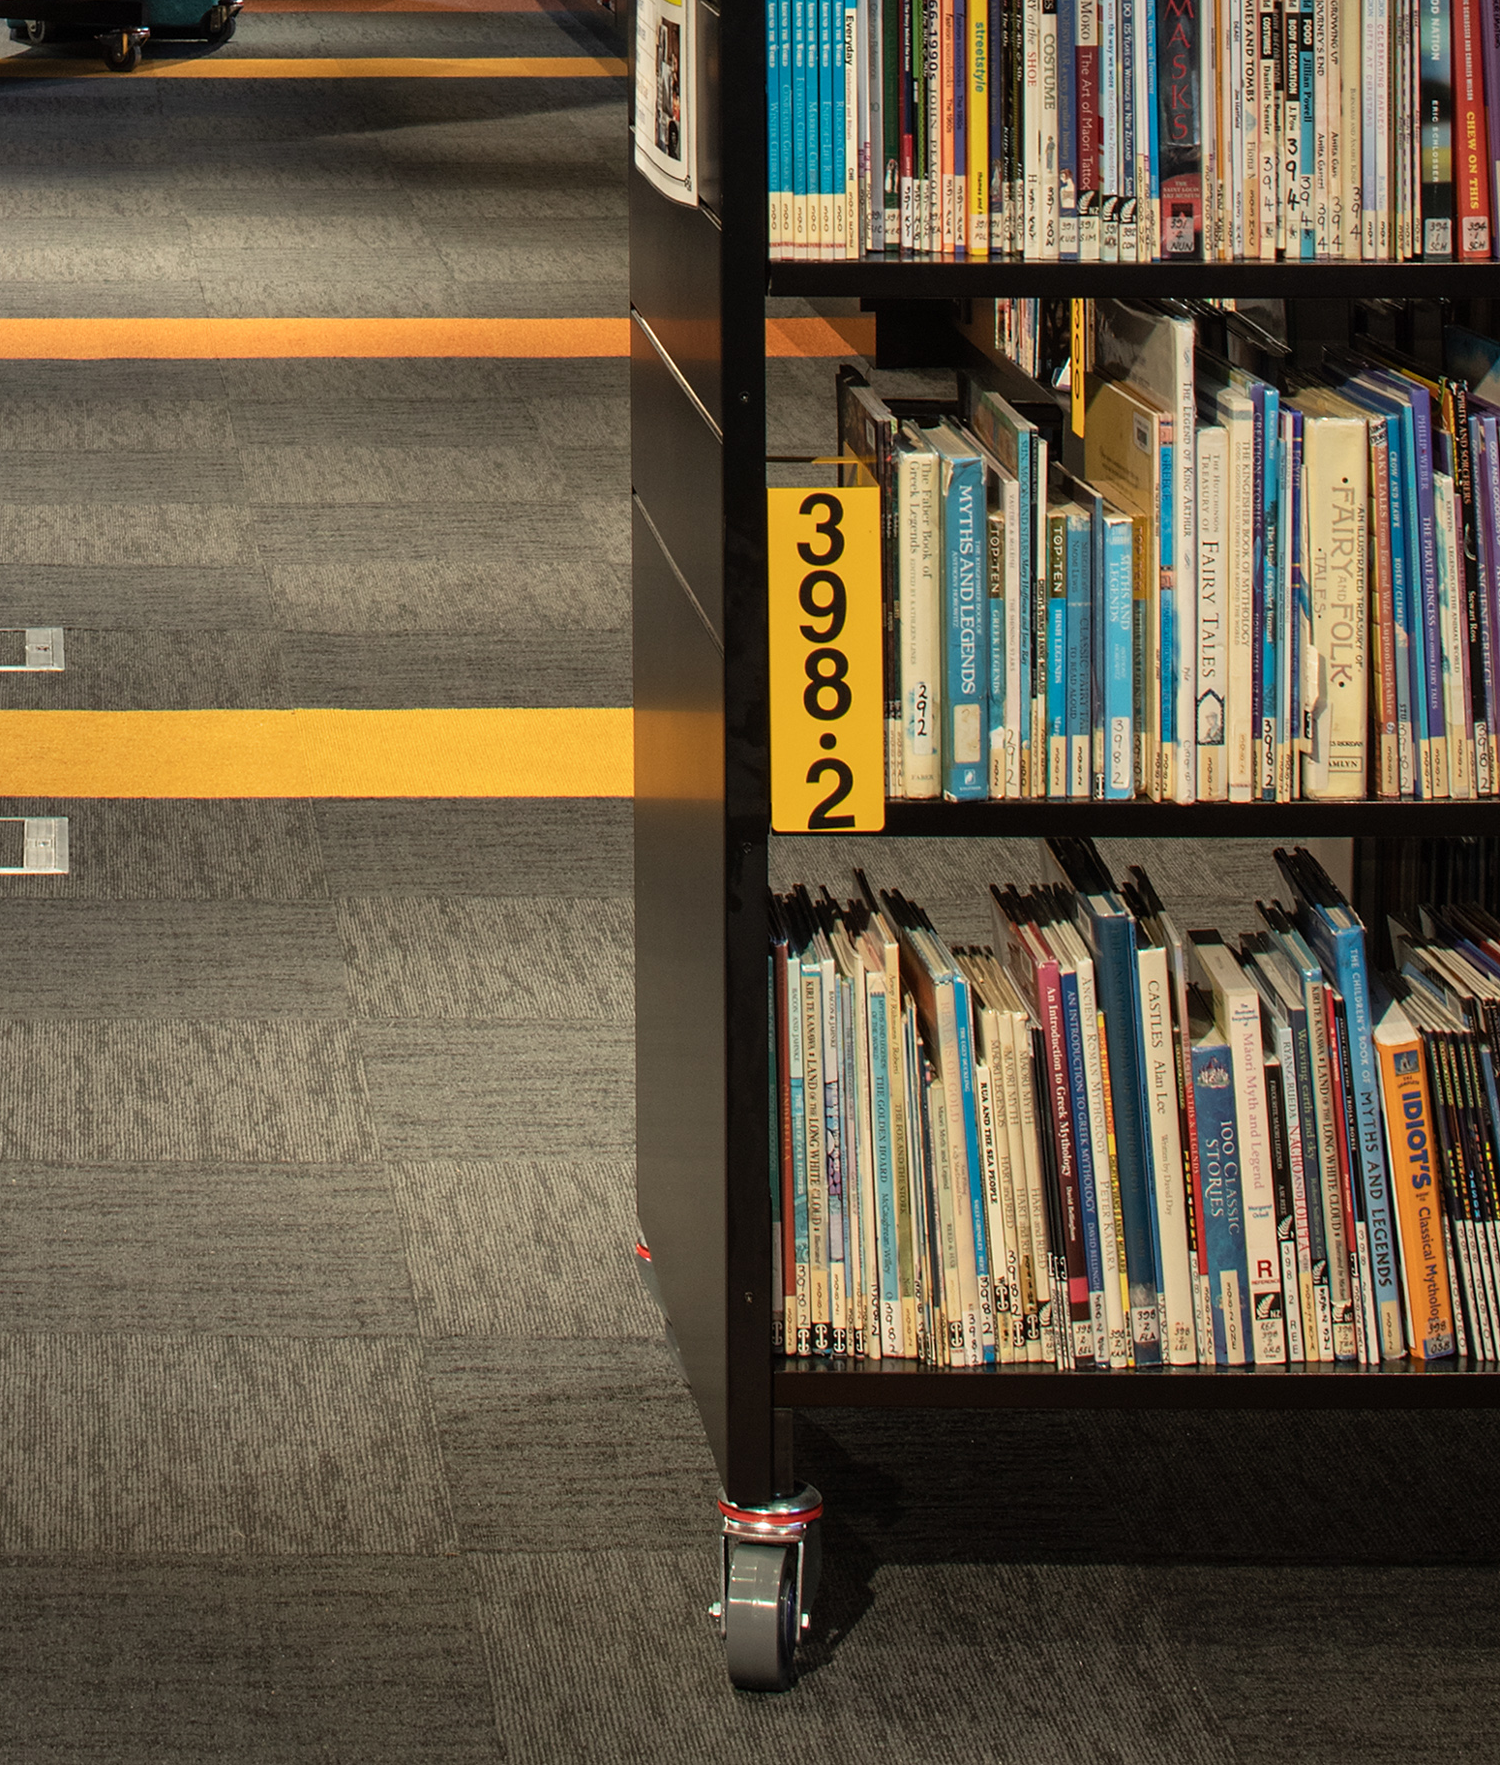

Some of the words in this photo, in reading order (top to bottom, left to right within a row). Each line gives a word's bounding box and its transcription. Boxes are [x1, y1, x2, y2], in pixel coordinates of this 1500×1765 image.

[1027, 14, 1037, 25] of
[1027, 28, 1037, 44] the
[1262, 16, 1271, 56] COSTUMES
[1287, 19, 1297, 40] BODY
[1302, 19, 1313, 46] FOOD
[1316, 0, 1325, 52] JOURNEY'S
[1330, 0, 1338, 46] GROWING
[845, 15, 854, 65] Everyday
[1245, 28, 1254, 52] AND
[1430, 18, 1440, 60] NATION
[974, 22, 987, 93] streetstyle
[1028, 52, 1038, 87] SHOE
[1043, 34, 1055, 110] COSTUME
[1081, 52, 1092, 75] The
[1287, 43, 1297, 95] DECORATION
[1302, 58, 1312, 87] Jillian
[1317, 57, 1325, 76] END
[1330, 50, 1338, 65] UP
[1081, 79, 1092, 97] Art
[1245, 56, 1255, 102] TOMBS
[928, 89, 937, 130] JOHN
[1081, 101, 1092, 114] of
[1303, 90, 1312, 122] Powell
[1081, 117, 1093, 152] Maori
[1466, 111, 1478, 150] CHEW
[1468, 155, 1478, 173] ON
[1469, 177, 1479, 209] THIS
[1183, 382, 1191, 399] THE
[1182, 404, 1192, 442] LEGEND
[922, 461, 931, 482] The
[1183, 447, 1192, 461] OF
[908, 461, 920, 495] Greek
[1183, 466, 1192, 492] KING
[922, 488, 931, 526] Faber
[959, 485, 973, 555] MYTHS
[1183, 497, 1193, 537] ARTHUR
[908, 497, 920, 554] Legends
[1266, 526, 1274, 540] The
[1331, 487, 1353, 572] FAIRY
[922, 532, 932, 560] Book
[1265, 542, 1274, 567] Magic
[923, 565, 932, 578] of
[960, 559, 973, 600] AND
[1119, 554, 1130, 598] MYTHS
[1201, 540, 1218, 604] FAIRY
[1266, 571, 1274, 582] of
[1314, 554, 1326, 615] TALES
[1337, 576, 1348, 601] AND
[1109, 562, 1120, 622] LEGENDS
[1265, 584, 1274, 613] Spider
[1121, 603, 1131, 630] AND
[1266, 616, 1274, 643] Woman
[961, 605, 976, 693] LEGENDS
[1202, 614, 1218, 678] TALES
[1330, 603, 1354, 681] FOLK
[795, 492, 856, 830] 398.2
[806, 981, 814, 1001] KIRI
[806, 1004, 815, 1012] TE
[1047, 987, 1056, 998] An
[1148, 980, 1163, 1048] CASTLES
[807, 1015, 816, 1049] KANAWA
[1047, 1001, 1062, 1069] Introduction
[807, 1060, 819, 1090] LAND
[1052, 1073, 1062, 1084] to
[1153, 1060, 1166, 1088] Alan
[1053, 1086, 1066, 1119] Greek
[1155, 1092, 1168, 1114] Lee
[1244, 1075, 1258, 1110] Myth
[809, 1118, 820, 1148] LONG
[1220, 1120, 1234, 1154] 100
[1247, 1114, 1260, 1139] and
[1361, 1091, 1379, 1153] MYTHS
[1055, 1123, 1073, 1177] Mythology
[1402, 1091, 1432, 1190] IDIOT'S
[809, 1150, 821, 1185] WHITE
[1205, 1139, 1224, 1217] STORIES
[1248, 1143, 1264, 1189] Legend
[1366, 1161, 1384, 1200] AND
[810, 1188, 822, 1225] CLOUD
[1223, 1162, 1240, 1235] CLASSIC
[1371, 1208, 1393, 1287] LEGENDS
[1418, 1208, 1435, 1261] Classical
